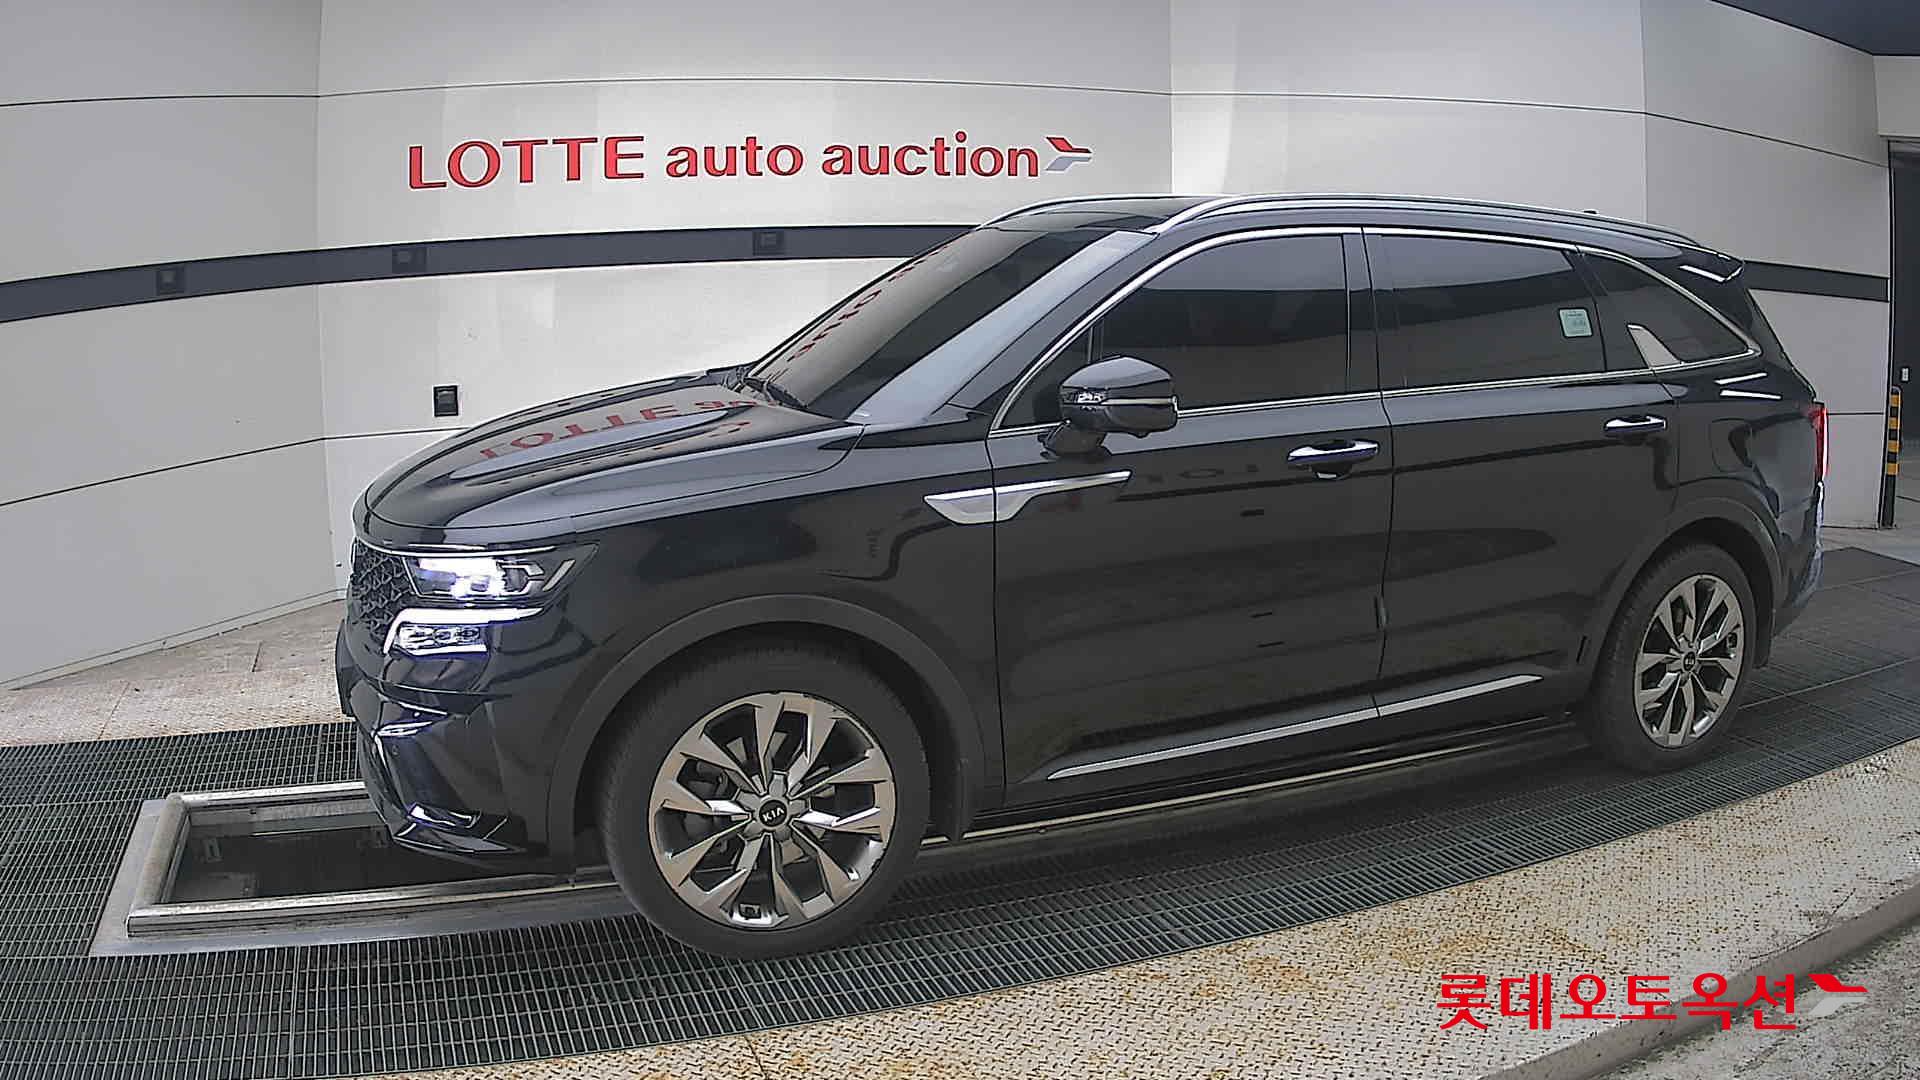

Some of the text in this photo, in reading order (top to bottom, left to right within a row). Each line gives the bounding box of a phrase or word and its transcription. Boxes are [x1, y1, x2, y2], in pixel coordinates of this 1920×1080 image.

[408, 131, 1039, 190] LOTTE auto auction
[762, 807, 785, 822] KIA
